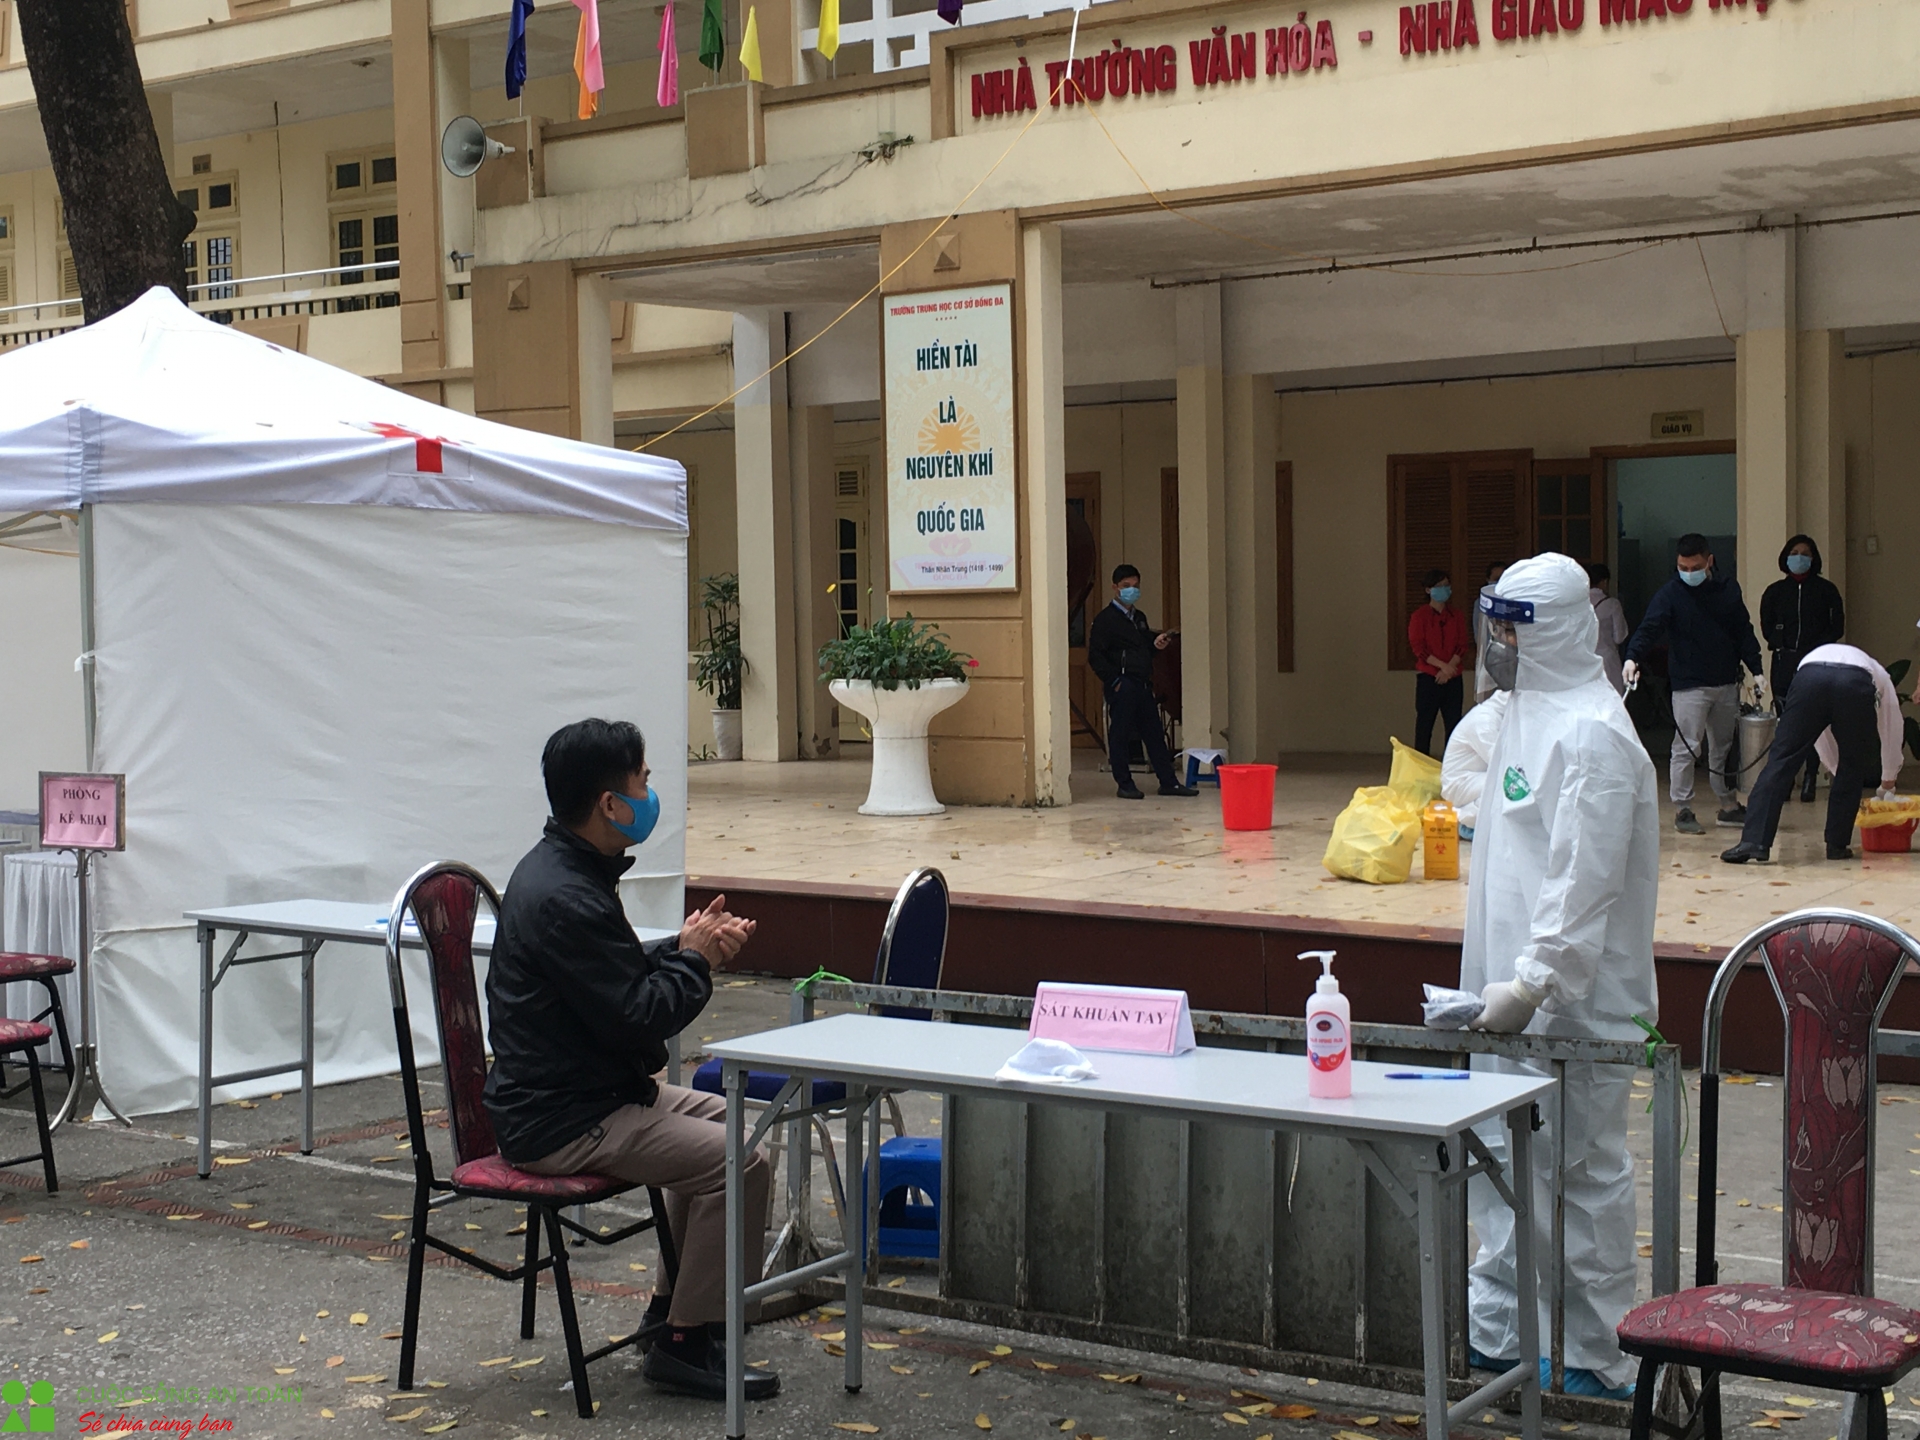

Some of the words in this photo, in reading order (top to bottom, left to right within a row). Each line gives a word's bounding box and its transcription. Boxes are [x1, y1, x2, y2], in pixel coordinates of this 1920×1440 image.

[971, 57, 1037, 117] NHÀ
[1045, 40, 1177, 106] TRƯỜNG
[1188, 26, 1257, 86] VĂN
[1265, 12, 1338, 75] HÓA
[916, 303, 938, 314] TRUNG
[939, 302, 952, 313] HỌC
[953, 300, 963, 310] CƠ
[964, 297, 974, 309] SỞ
[916, 338, 951, 371] HIỀN
[954, 339, 978, 368] TÀI
[939, 395, 957, 424] LÀ
[1661, 423, 1680, 434] GIÁO
[1682, 424, 1692, 436] VỤ
[906, 450, 964, 480] NGUYÊN
[968, 447, 993, 477] KHÍ
[917, 501, 956, 536] QUỐC
[960, 508, 985, 532] GIA
[921, 565, 935, 573] Thân
[936, 565, 950, 573] Nhân
[951, 565, 968, 574] Trung
[62, 786, 101, 800] PHÒNG
[59, 810, 75, 824] KÊ
[80, 814, 107, 826] KHAI
[1039, 1001, 1070, 1017] SÁT
[1134, 1011, 1168, 1025] TAY
